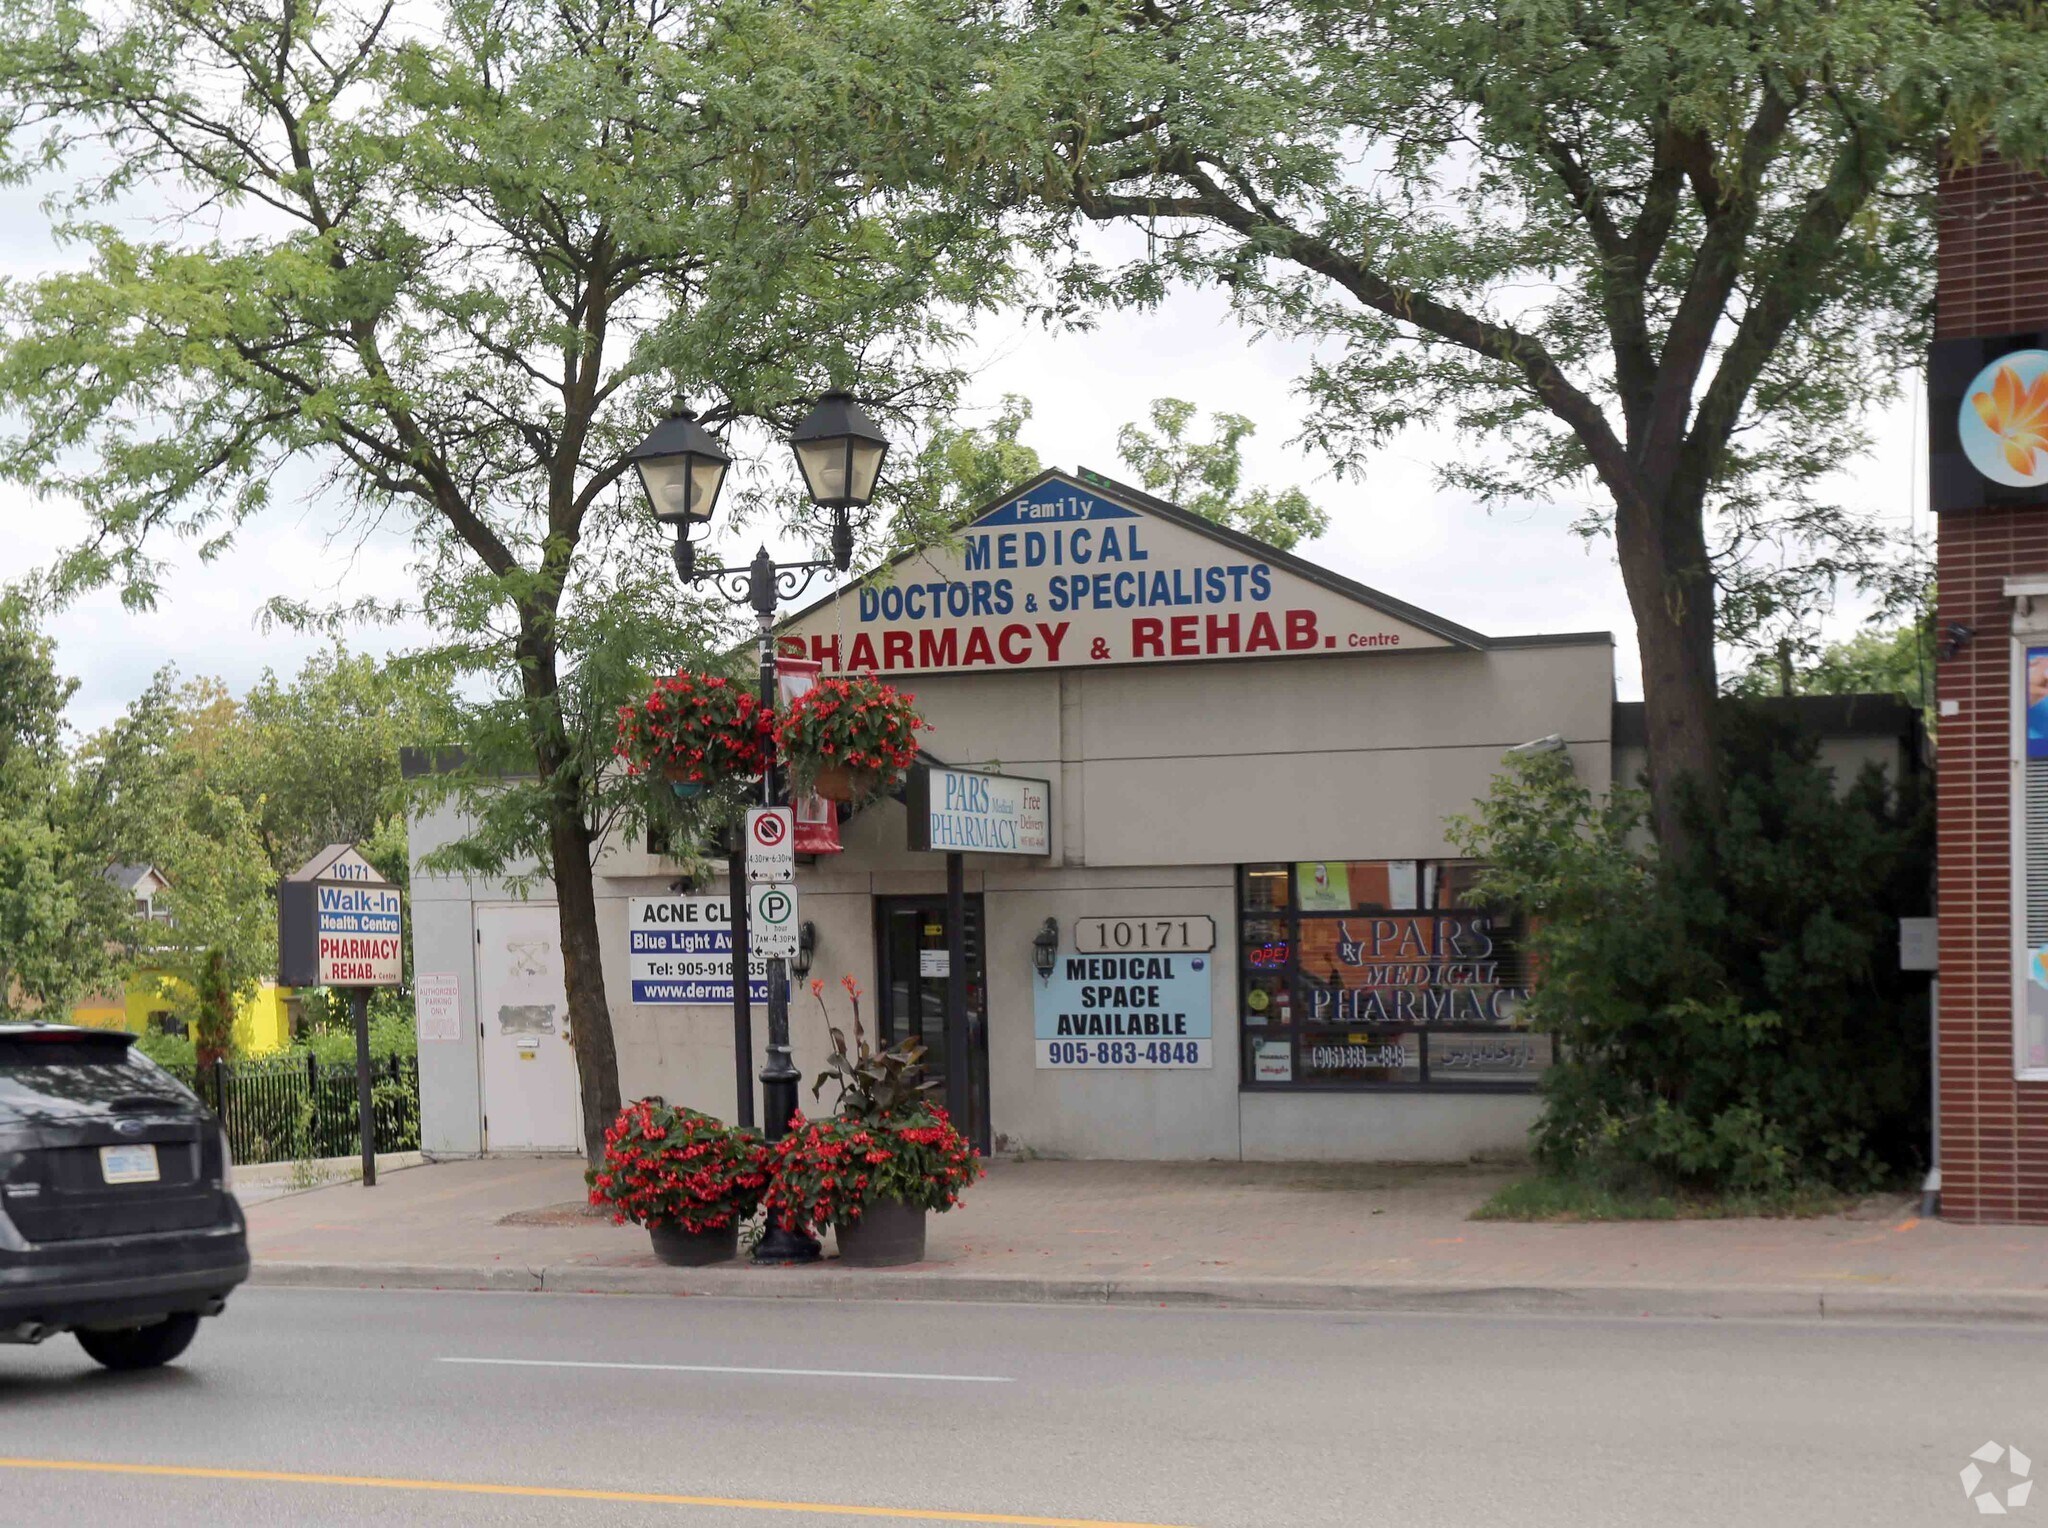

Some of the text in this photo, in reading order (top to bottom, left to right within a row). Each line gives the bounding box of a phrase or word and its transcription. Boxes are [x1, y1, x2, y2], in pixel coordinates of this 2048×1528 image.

[1016, 497, 1094, 520] Family
[964, 525, 1148, 571] MEDICAL
[859, 563, 1271, 622] DOCTORS & SPECIALISTS
[1090, 636, 1111, 660] &
[1131, 609, 1337, 658] REHAB.
[1348, 631, 1399, 648] Centre
[944, 773, 989, 814] PARS
[1023, 787, 1041, 810] Free
[931, 813, 1018, 850] PHARMACY
[332, 863, 368, 880] 10171
[320, 888, 398, 912] Walk-In
[768, 897, 785, 919] P
[320, 914, 398, 932] Health Centre
[643, 903, 698, 922] ACNE
[633, 932, 666, 949] Blue
[671, 932, 710, 953] Light
[1096, 922, 1191, 949] 10171
[1368, 918, 1493, 959] PARS
[320, 938, 398, 960] PHARMACY
[332, 963, 376, 980] REHAB.
[647, 962, 673, 976] Tel:
[1066, 958, 1175, 981] MEDICAL
[1366, 963, 1500, 986] MEDICAL
[1081, 986, 1160, 1009] SPACE
[430, 1007, 448, 1016] ONLY
[1057, 1013, 1187, 1036] AVAILABLE
[1049, 1041, 1199, 1064] 905-883-4848
